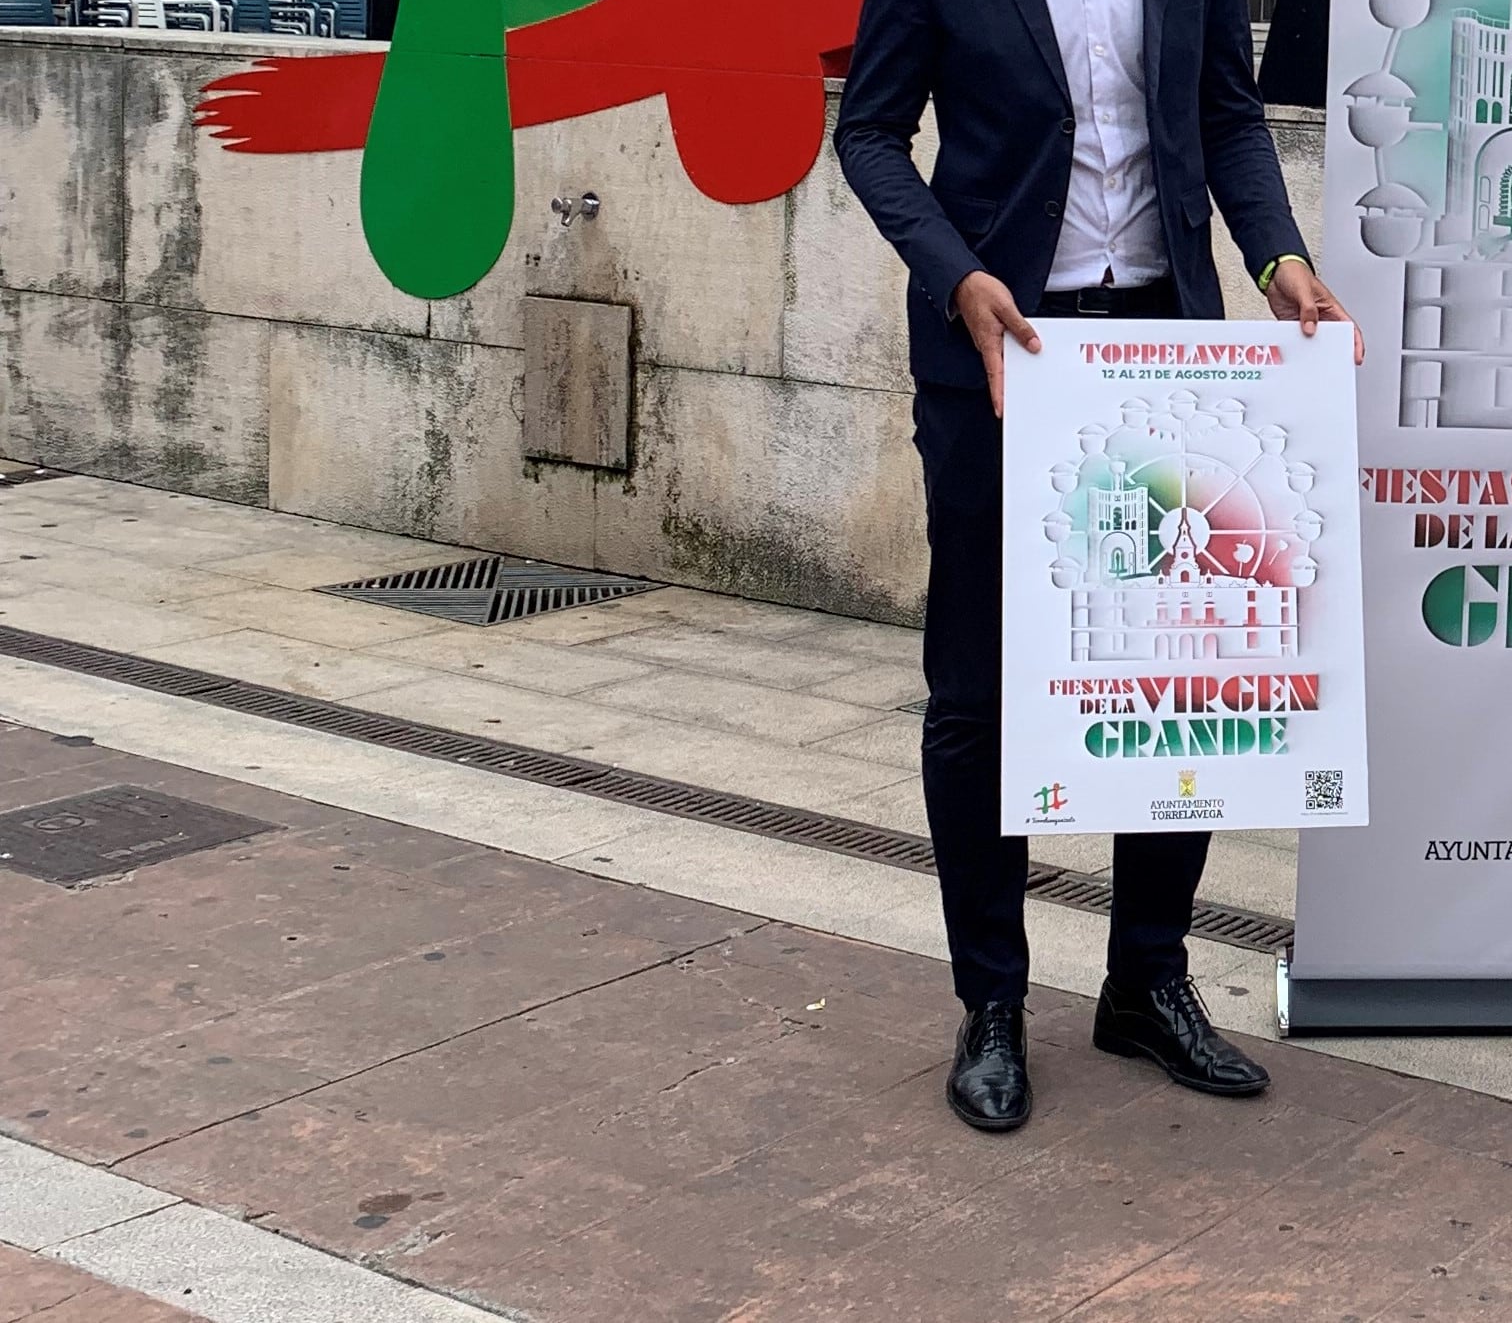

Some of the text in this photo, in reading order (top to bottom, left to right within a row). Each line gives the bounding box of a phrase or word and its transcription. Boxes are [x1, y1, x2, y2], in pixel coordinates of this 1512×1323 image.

[1080, 343, 1283, 365] TORRELAVEGA
[1102, 369, 1262, 380] 12 AL 21 DE AGOSTO 2022
[1414, 514, 1474, 549] DE
[1050, 679, 1135, 696] FIESTAS
[1136, 674, 1319, 714] VIRGEN
[1080, 699, 1136, 715] DE LA
[1084, 718, 1288, 758] GRANDE
[1150, 798, 1225, 810] AYUNTAMIENTO
[1151, 809, 1224, 821] TORRELAVEGA
